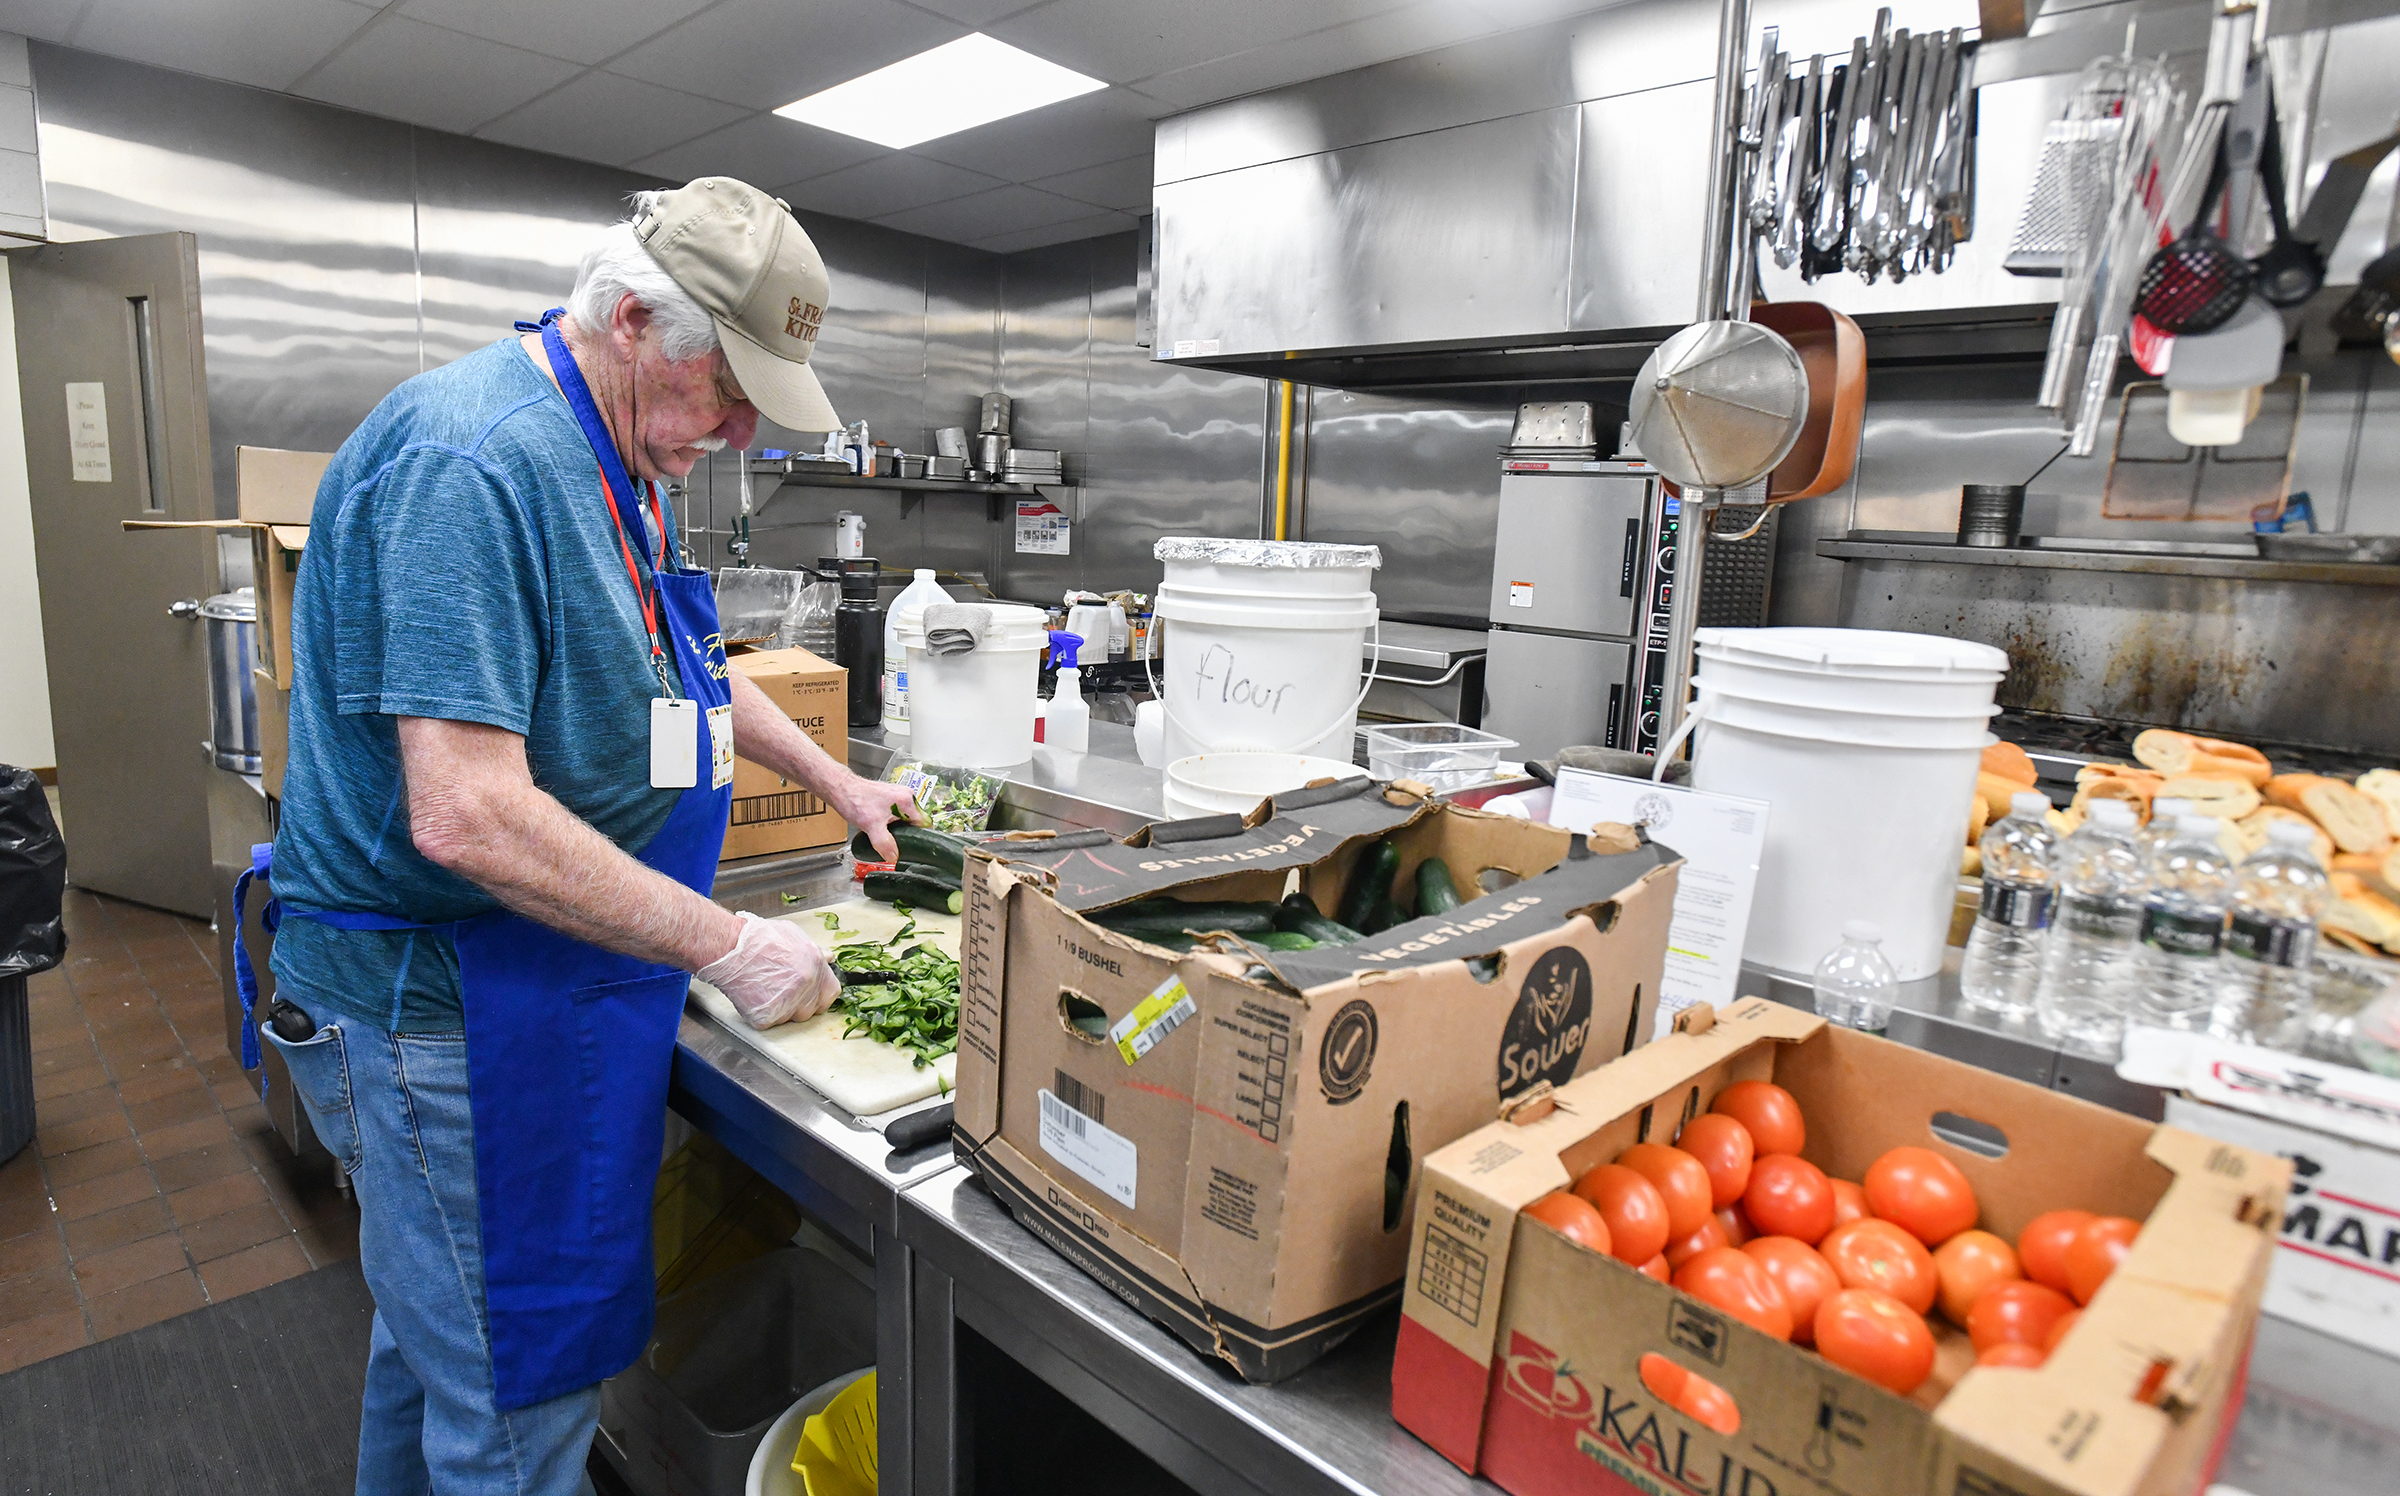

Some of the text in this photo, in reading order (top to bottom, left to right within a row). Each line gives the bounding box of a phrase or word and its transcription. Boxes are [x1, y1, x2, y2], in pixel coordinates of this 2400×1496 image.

[82, 422, 95, 431] Keep
[1195, 643, 1296, 714] Flour
[791, 716, 824, 728] TUCE
[1139, 824, 1322, 872] VEGETABLES
[1358, 896, 1542, 962] VEGETABLES
[1057, 935, 1124, 977] 1 1/9 BUSHEL
[1214, 1017, 1268, 1042] SUPER SELECT
[1237, 1049, 1265, 1065] SELECT
[1501, 1017, 1590, 1091] Sower
[1238, 1072, 1263, 1087] SMALL
[1236, 1092, 1261, 1108] LARGE
[1237, 1115, 1259, 1128] PLAIN
[1059, 1199, 1081, 1219] GREEN
[1435, 1190, 1490, 1229] PREMIUM
[1094, 1223, 1109, 1238] RED
[1434, 1206, 1487, 1242] QUALITY
[1023, 1212, 1140, 1306] WWW.MALENAPRODUCE.COM
